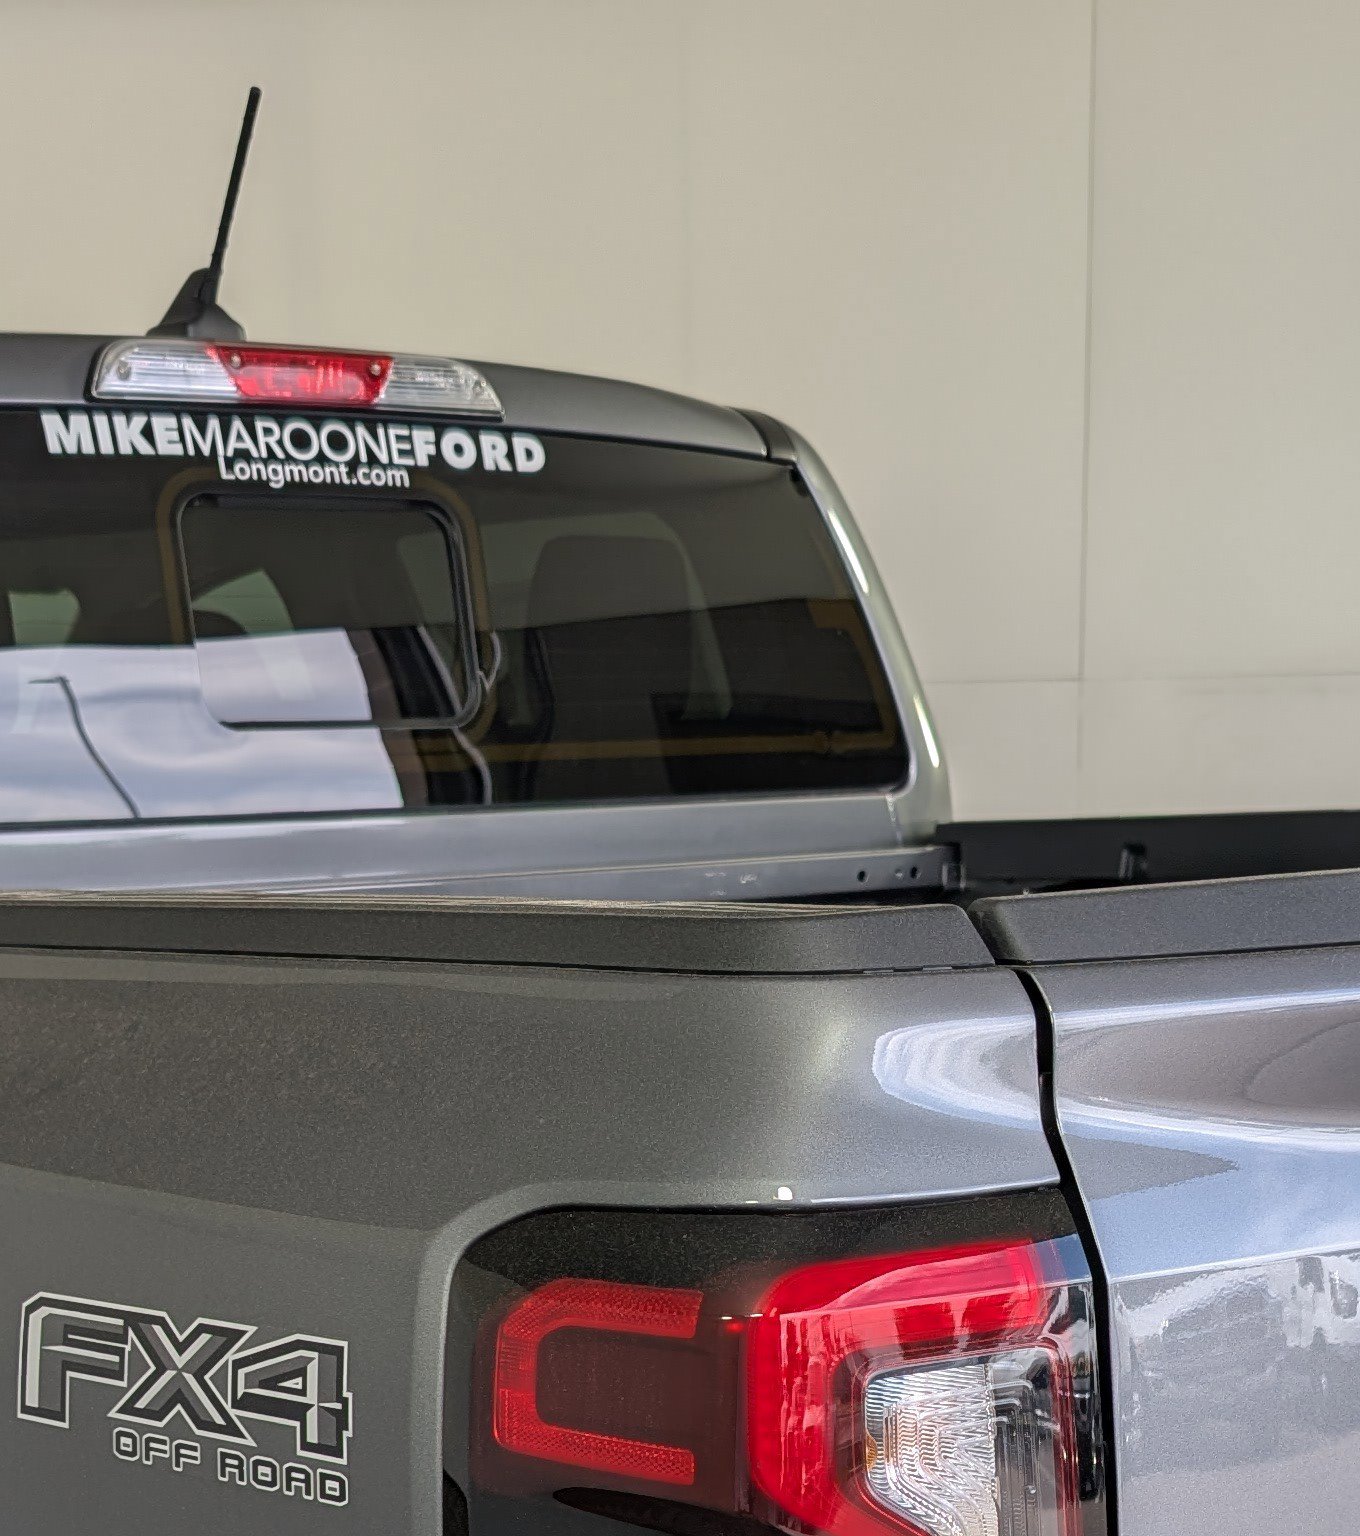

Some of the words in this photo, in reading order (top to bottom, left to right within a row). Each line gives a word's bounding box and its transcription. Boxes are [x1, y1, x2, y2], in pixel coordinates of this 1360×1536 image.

[218, 454, 410, 490] Longmont.com
[17, 1291, 353, 1465] FX4
[113, 1426, 201, 1472] OFF
[217, 1447, 349, 1507] ROAD
